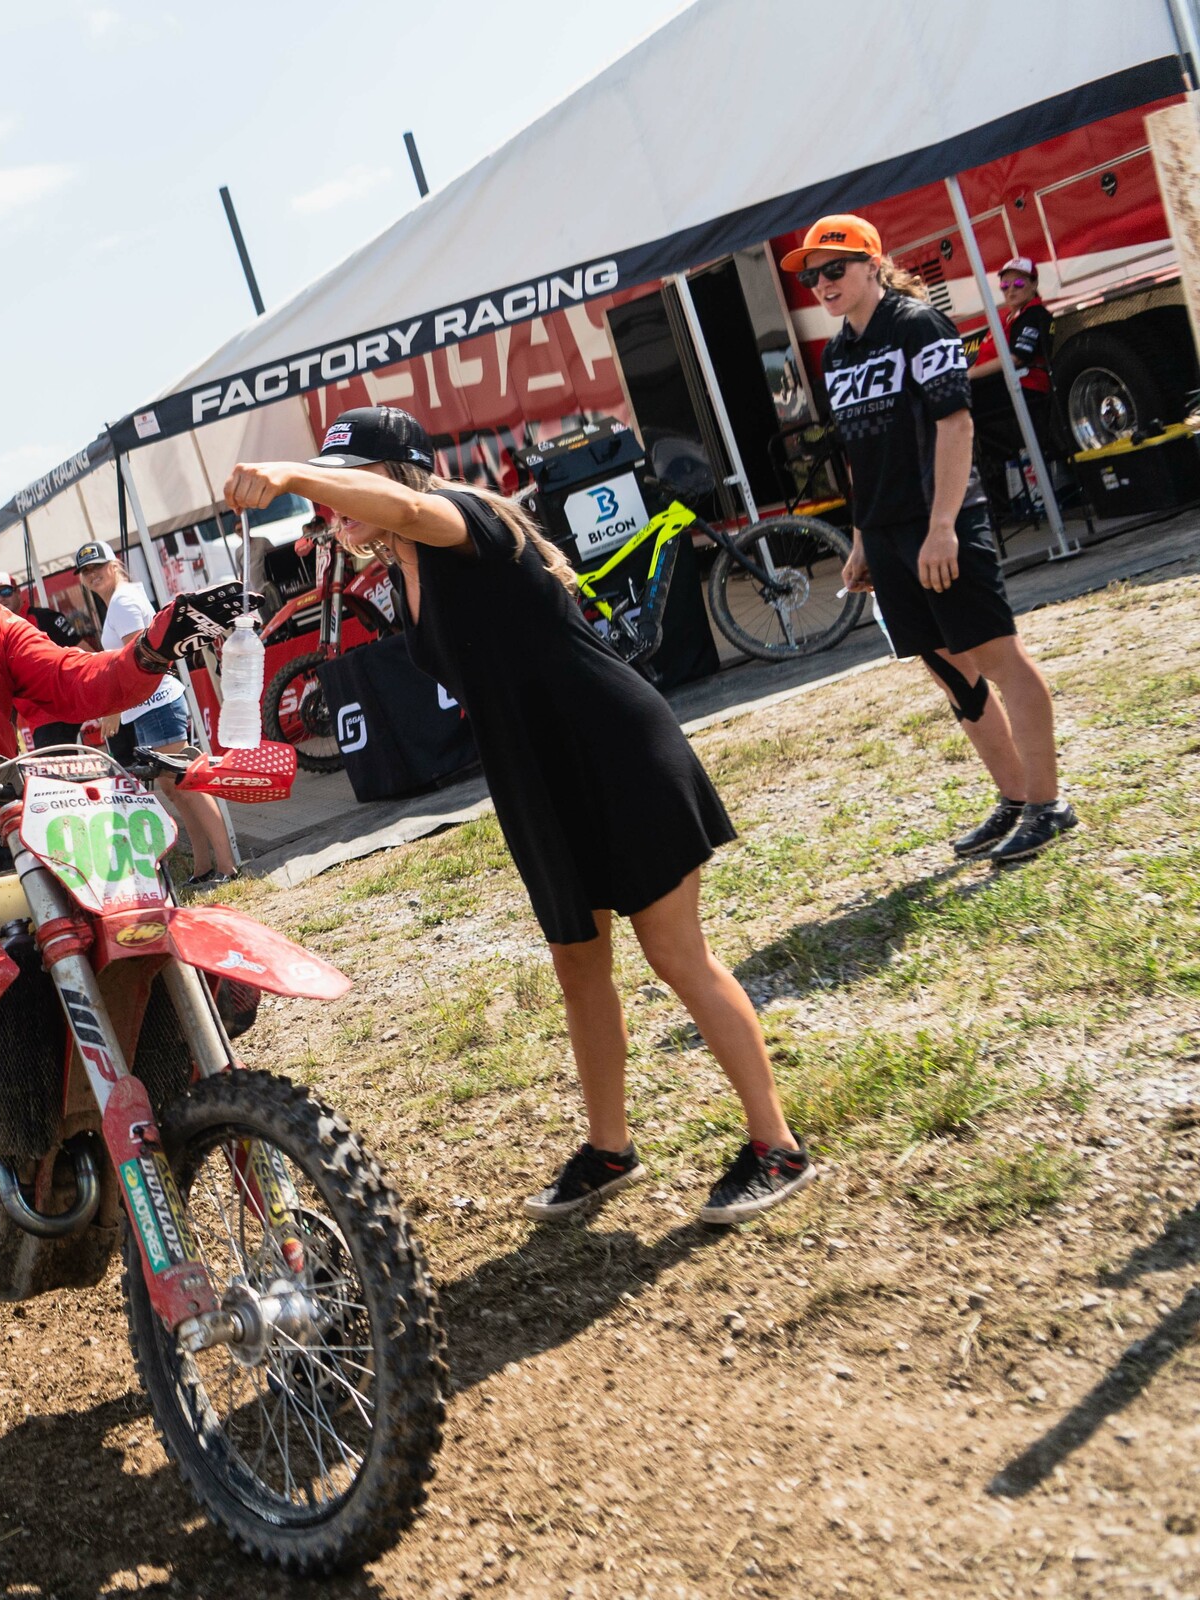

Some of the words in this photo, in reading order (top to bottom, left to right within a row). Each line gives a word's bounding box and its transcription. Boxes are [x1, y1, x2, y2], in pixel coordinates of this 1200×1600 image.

[192, 321, 423, 424] FACTORY
[435, 260, 619, 345] RACING
[964, 338, 980, 355] TAL
[829, 358, 897, 406] FXR
[15, 472, 54, 514] FACTORY
[54, 447, 91, 488] RACING
[24, 760, 109, 777] RENTHAL
[208, 776, 273, 787] ACERBIS
[46, 810, 167, 889] 969
[102, 892, 159, 905] GASGAS
[116, 924, 167, 942] FMF
[131, 1186, 166, 1267] MOTOREX
[140, 1157, 184, 1260] DUNLOP
[156, 1154, 197, 1260] ACERBIS
